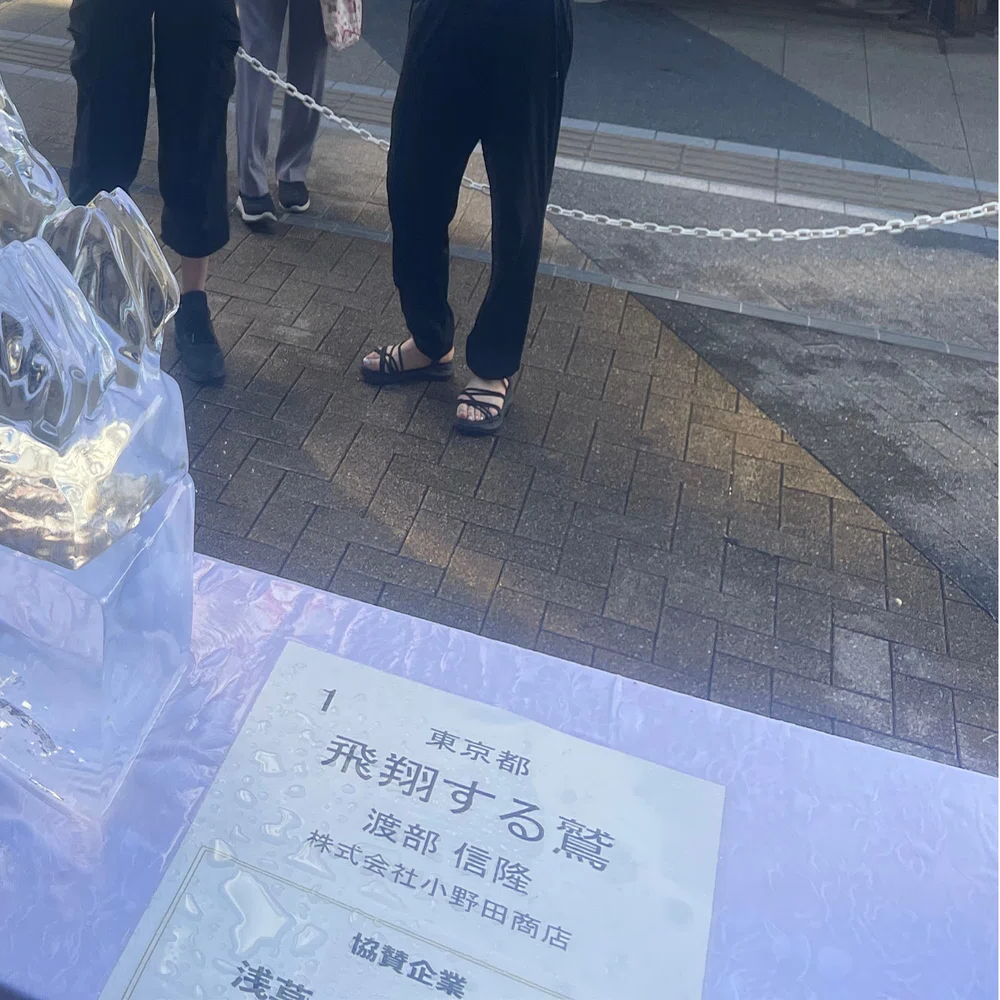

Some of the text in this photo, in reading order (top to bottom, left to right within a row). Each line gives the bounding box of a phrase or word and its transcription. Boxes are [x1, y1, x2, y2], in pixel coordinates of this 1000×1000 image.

[321, 688, 338, 712] 1
[425, 727, 531, 777] 東京都
[321, 734, 616, 872] 飛翔する鷲
[307, 829, 574, 951] 株式会社小野田商店
[362, 808, 533, 896] 渡部 信隆
[350, 932, 468, 1000] 協賛企業
